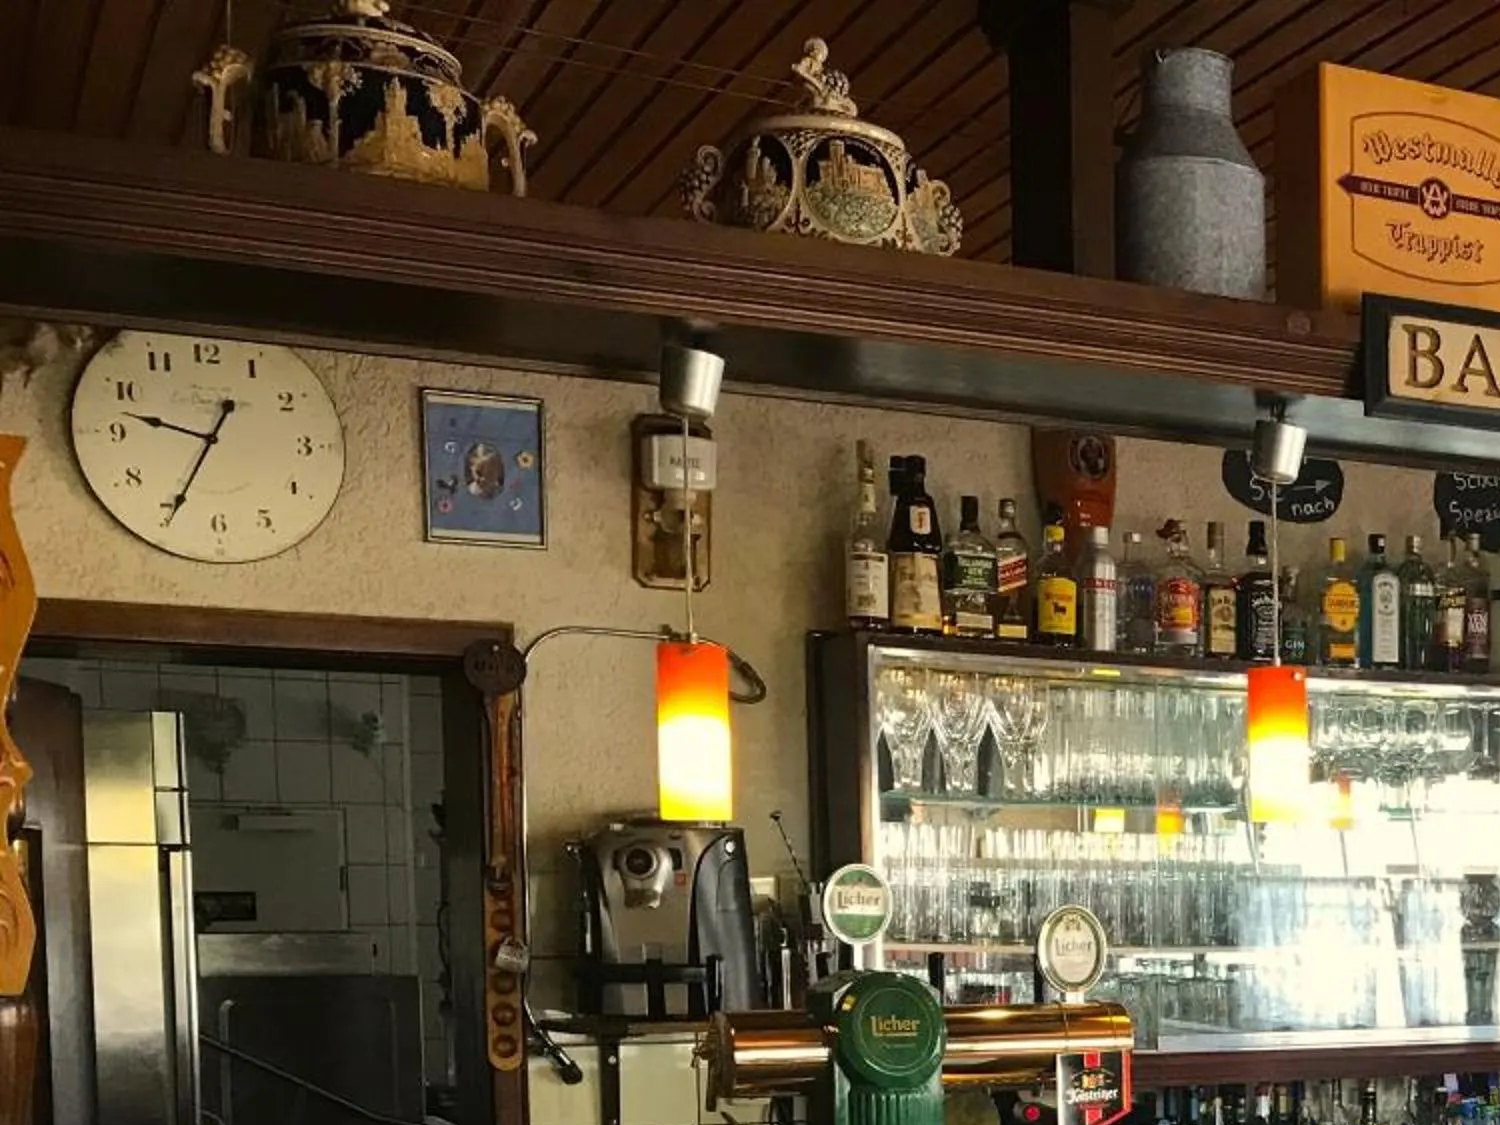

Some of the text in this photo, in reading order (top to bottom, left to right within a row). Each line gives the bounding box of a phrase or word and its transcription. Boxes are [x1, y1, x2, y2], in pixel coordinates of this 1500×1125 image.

[1385, 221, 1484, 264] Trappist
[148, 351, 171, 371] 11
[193, 343, 220, 365] 12
[248, 359, 257, 379] 1
[116, 381, 143, 402] 10
[277, 391, 295, 412] 2
[109, 422, 127, 443] 9
[297, 435, 314, 457] 3
[125, 466, 143, 488] 8
[1291, 495, 1335, 516] nach
[210, 513, 228, 533] 6
[256, 509, 273, 529] 5
[836, 890, 881, 909] Licher
[870, 1014, 921, 1037] Licher
